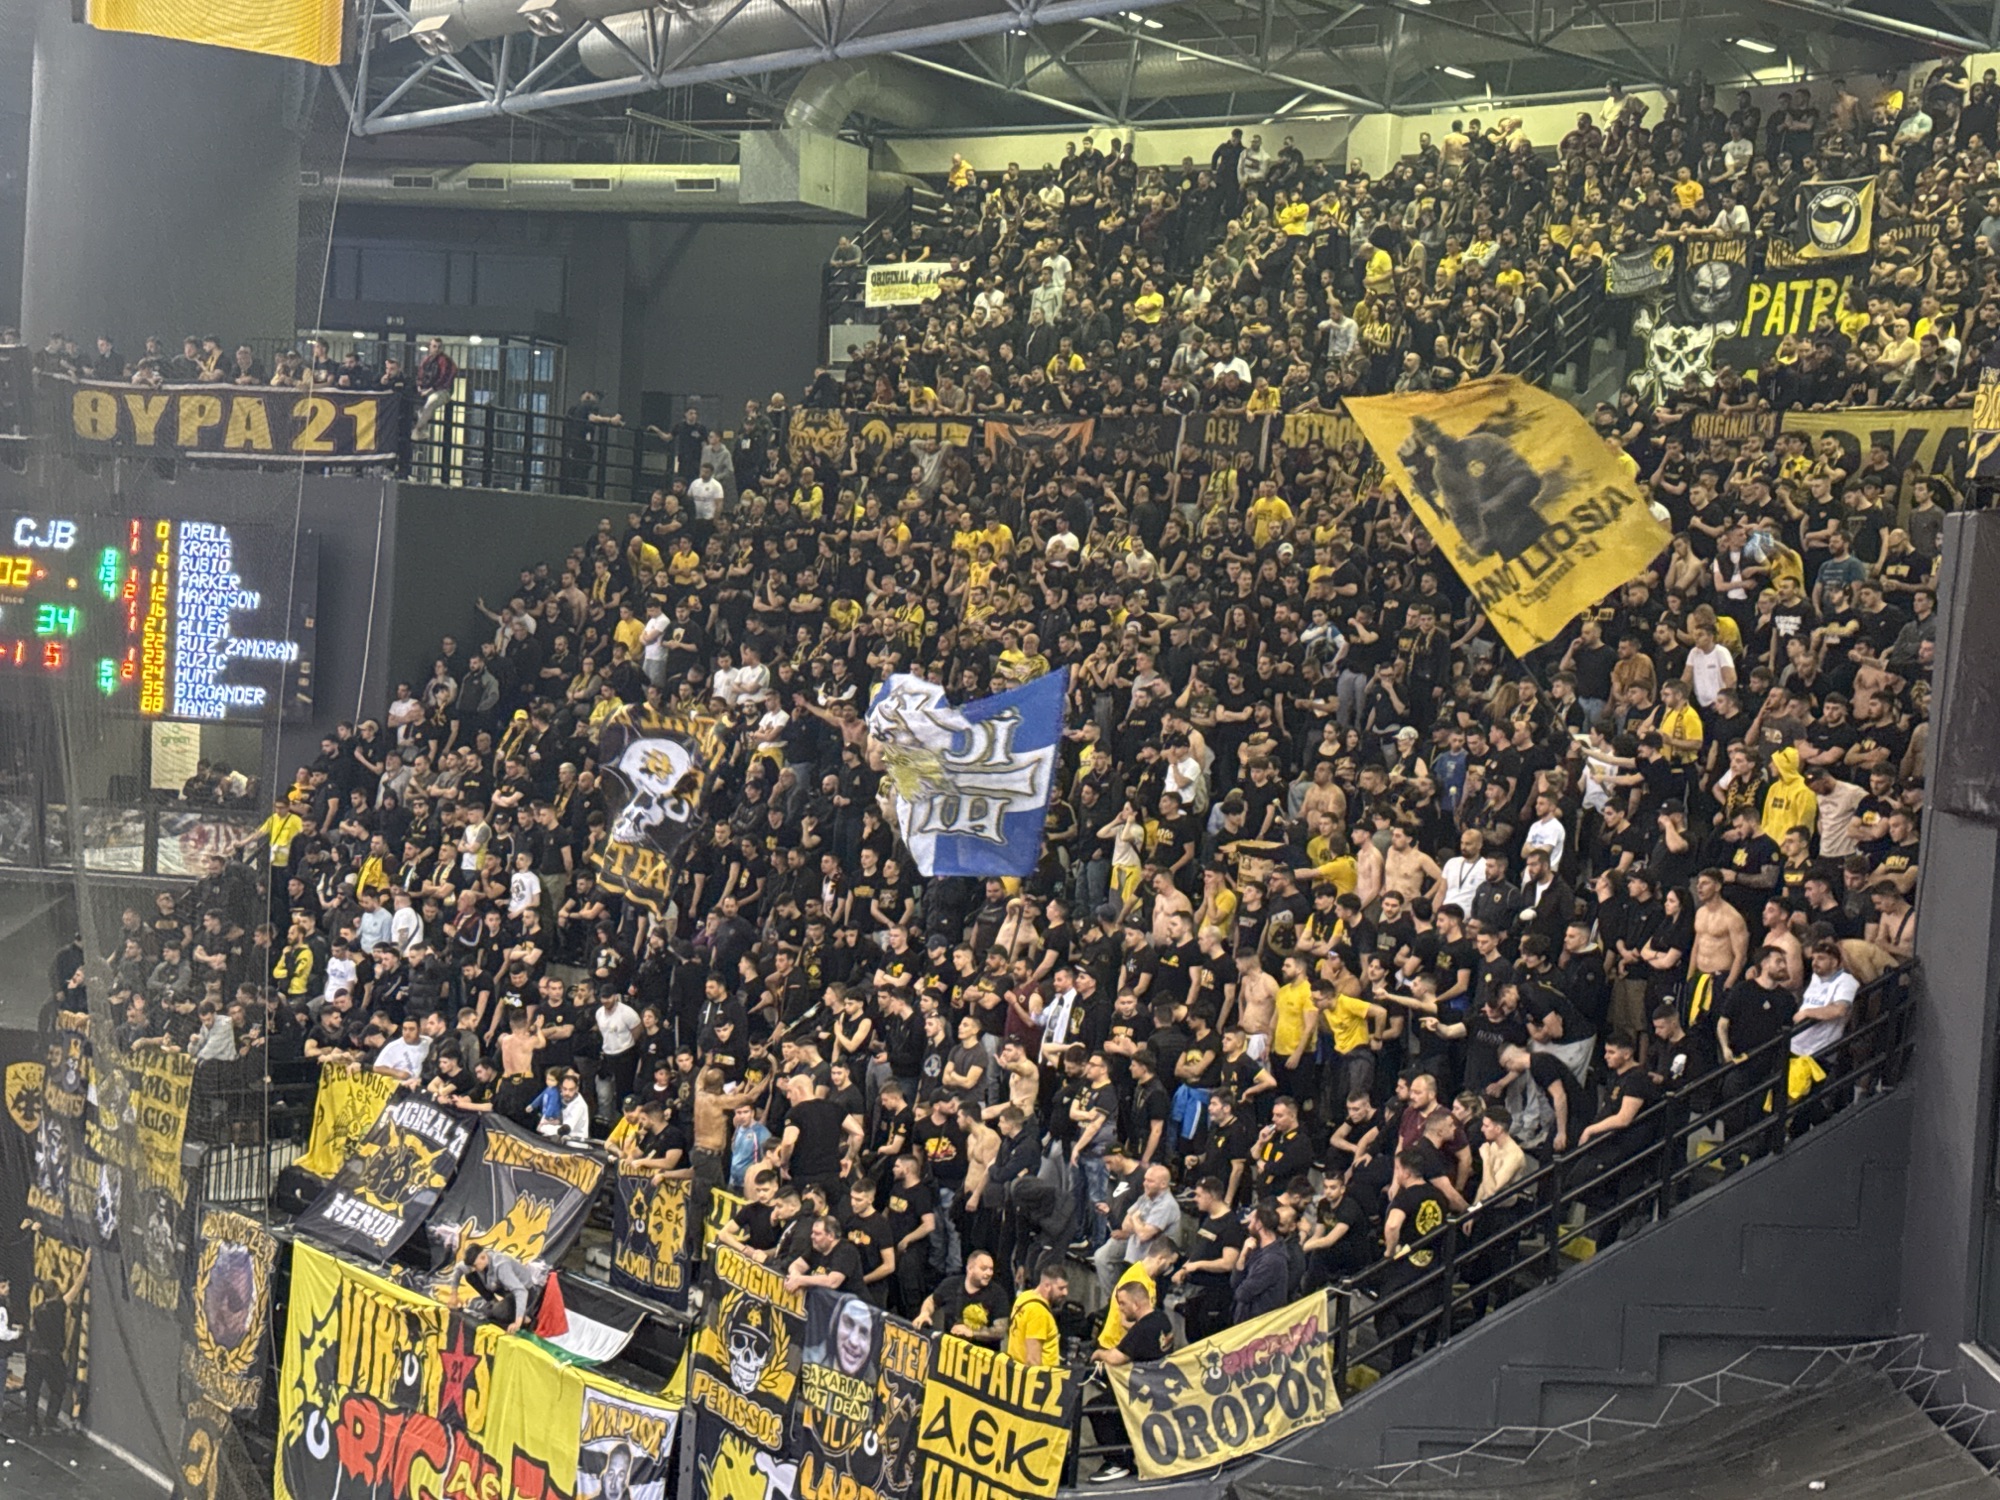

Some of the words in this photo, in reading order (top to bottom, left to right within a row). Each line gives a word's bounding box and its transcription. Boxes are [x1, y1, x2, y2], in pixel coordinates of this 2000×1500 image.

[871, 270, 910, 286] ORIGINAL
[72, 389, 274, 451] ΘΥΡΑ
[290, 396, 380, 453] 21
[14, 517, 77, 550] CJB
[131, 519, 140, 535] 1
[157, 521, 170, 539] 0
[180, 521, 231, 543] DRELL
[131, 536, 139, 553] 1
[163, 539, 169, 553] 1
[179, 540, 232, 559] KRAAG
[99, 565, 116, 582] 13
[131, 567, 138, 583] 1
[152, 568, 169, 585] 11
[156, 553, 169, 570] 9
[178, 556, 232, 574] RUBIO
[103, 582, 116, 600] 4
[123, 583, 136, 600] 2
[152, 585, 168, 601] 12
[177, 586, 261, 609] HAKANSON
[36, 604, 76, 636] 34
[151, 602, 167, 617] 16
[144, 616, 168, 633] 21
[177, 619, 231, 639] ALLEN
[44, 640, 63, 668] 5
[143, 633, 167, 649] 22
[176, 635, 219, 653] RUIZ
[100, 658, 114, 677] 5
[121, 662, 133, 679] 2
[142, 664, 165, 680] 24
[174, 667, 218, 685] HUNT
[143, 648, 166, 665] 23
[175, 650, 228, 670] RUZIC
[99, 677, 114, 695] 4
[142, 680, 165, 696] 35
[141, 696, 165, 712] 88
[173, 698, 226, 718] HANGA
[322, 1192, 405, 1242] MENIDI
[614, 1240, 651, 1284] LAMIA
[652, 1260, 685, 1291] CLUB
[715, 1244, 809, 1321] ORIGINAL
[451, 1360, 463, 1384] 21
[937, 1333, 1072, 1418] ΠΕΙΡΑΤΕΣ
[691, 1368, 784, 1450] PERISSOS
[833, 1396, 870, 1422] DEAD
[1140, 1356, 1328, 1467] OROPOS
